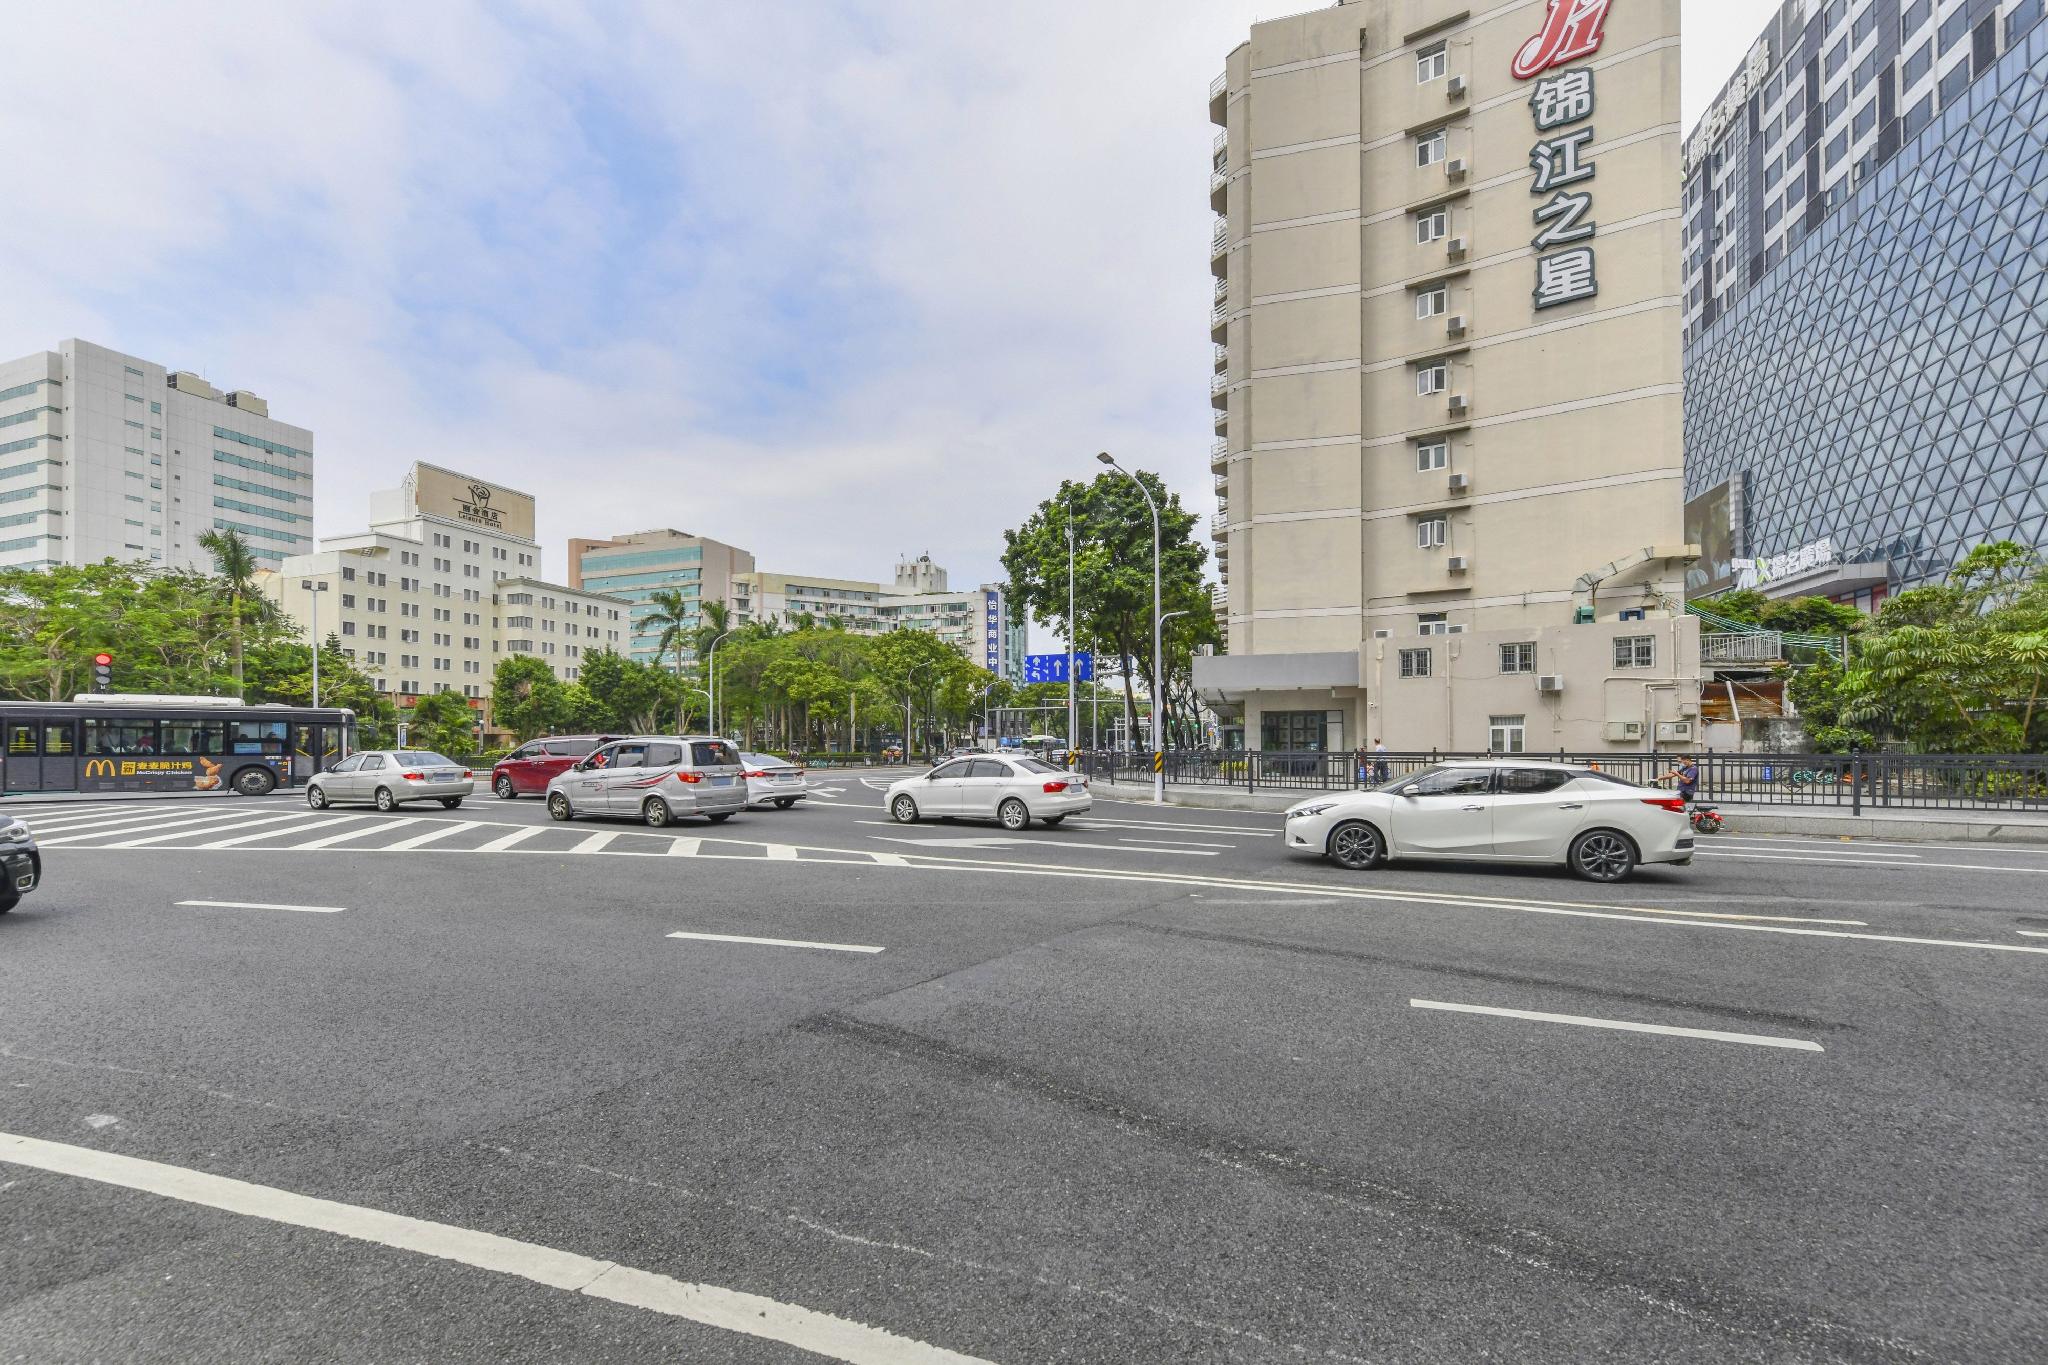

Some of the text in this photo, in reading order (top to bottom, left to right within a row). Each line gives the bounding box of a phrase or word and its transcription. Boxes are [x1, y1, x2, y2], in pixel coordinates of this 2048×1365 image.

[1530, 68, 1597, 308] 锦江之星
[987, 600, 998, 673] 怡华商业中
